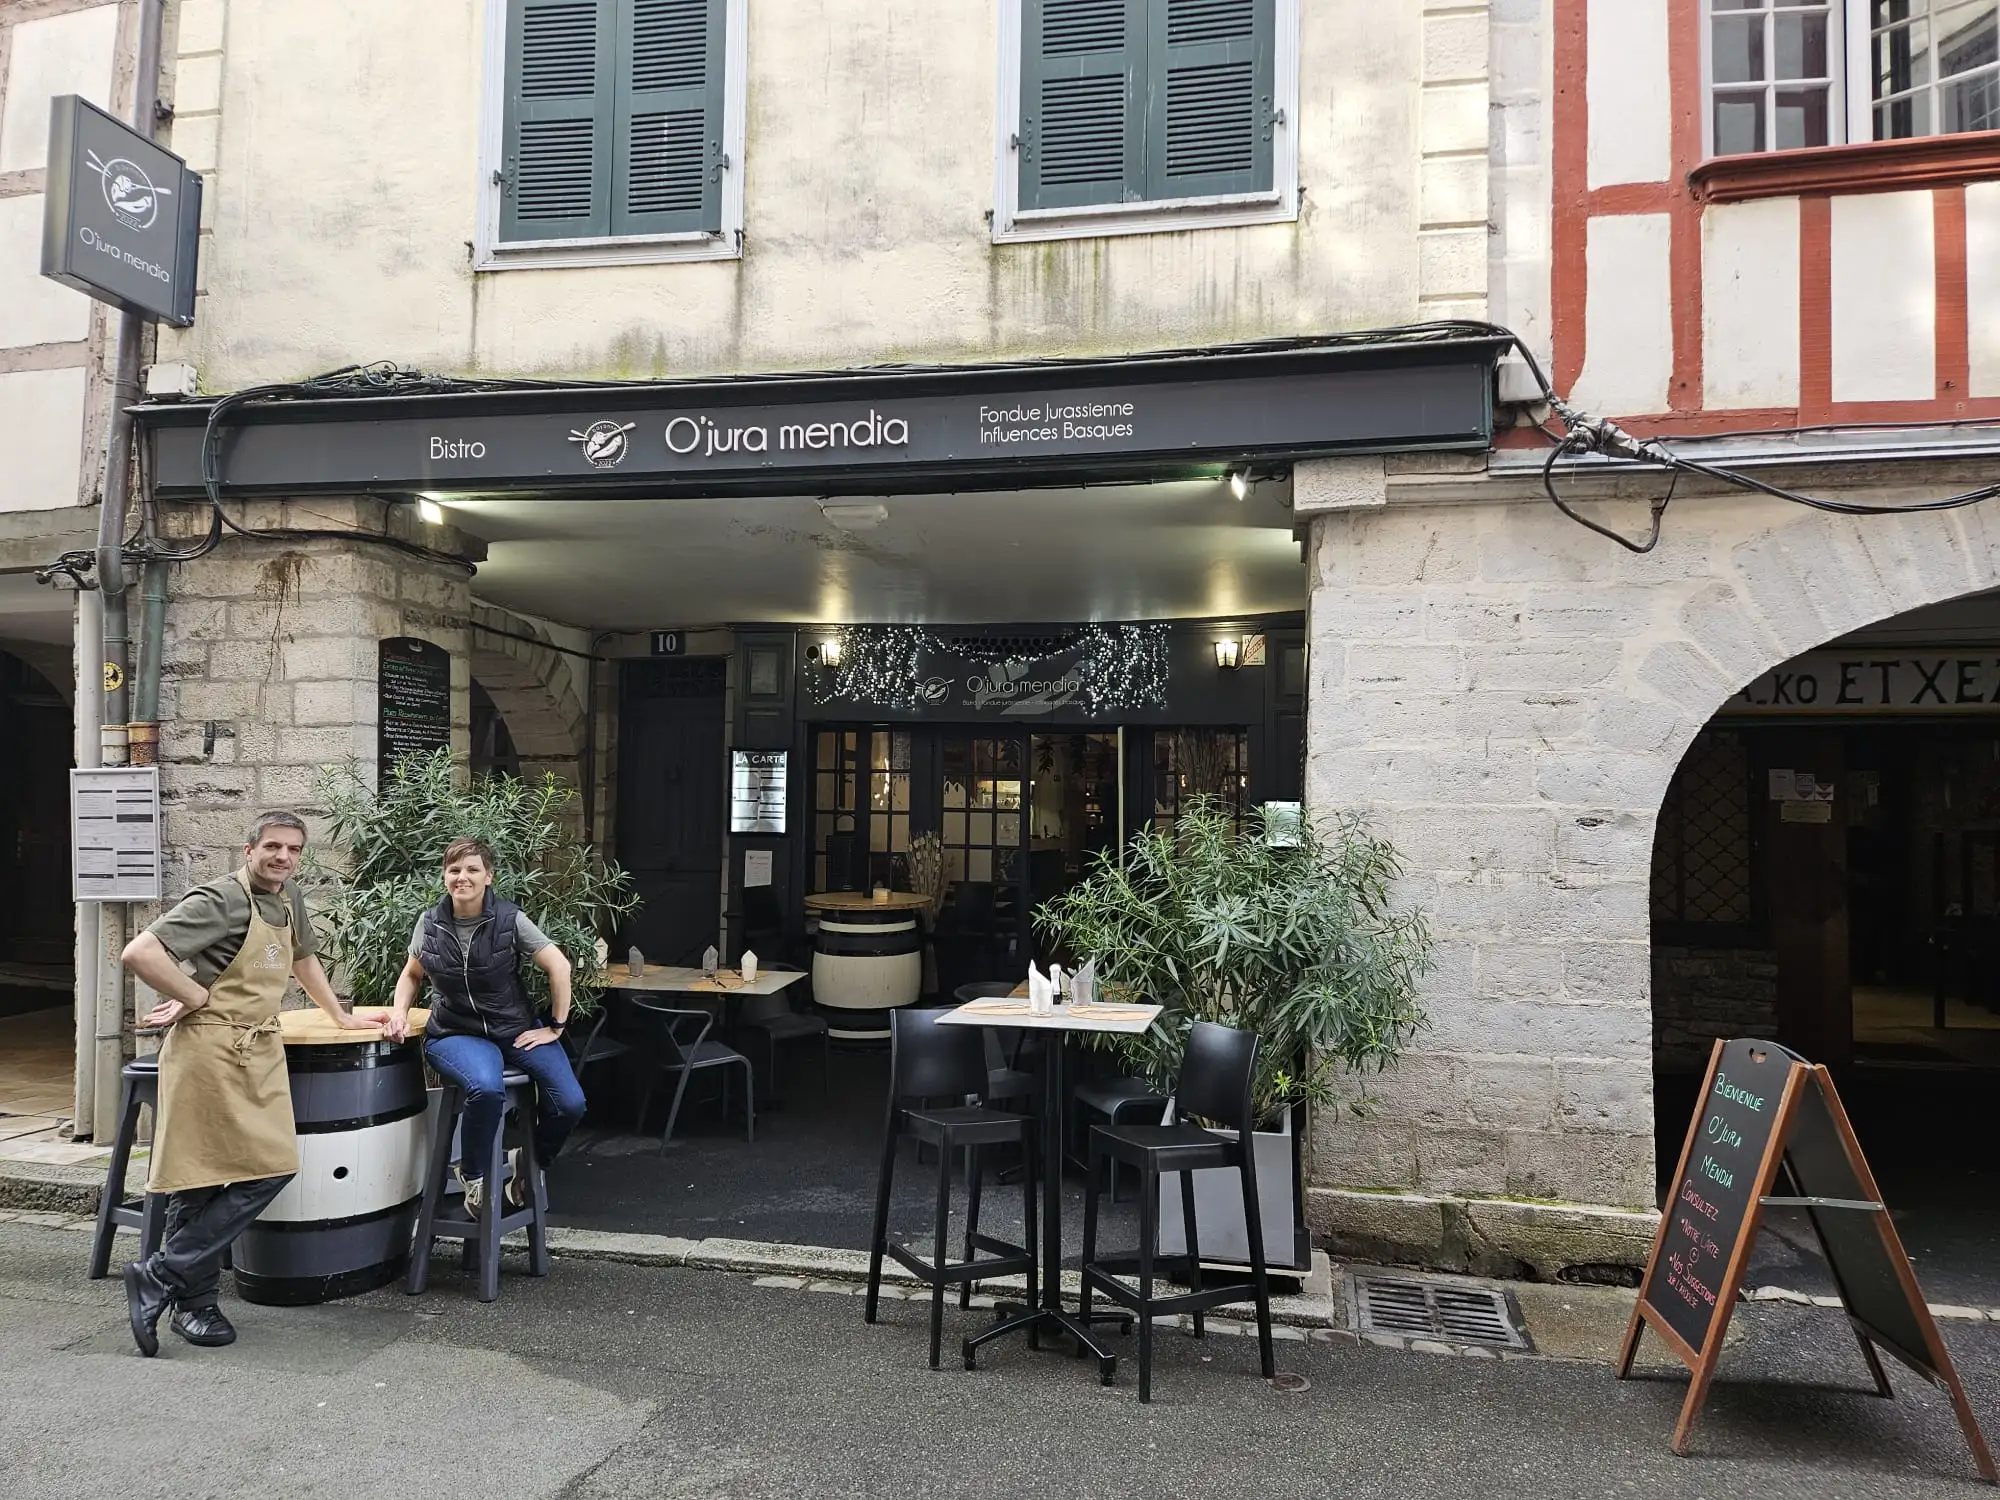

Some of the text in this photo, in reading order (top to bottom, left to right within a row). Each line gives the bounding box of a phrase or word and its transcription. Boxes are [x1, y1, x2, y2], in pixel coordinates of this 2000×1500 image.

[80, 227, 170, 283] O'jura mendia
[980, 402, 1134, 423] Fondue Jurassienne
[665, 408, 908, 457] O'jura mendia
[980, 421, 1133, 444] Influences Basques
[430, 436, 486, 460] Bistro
[658, 633, 677, 652] 10
[966, 675, 1080, 694] O'jura mendia
[736, 755, 785, 764] LA CARTE
[1708, 1115, 1742, 1148] O'JURA
[1681, 1179, 1719, 1222] CONSULTEZ
